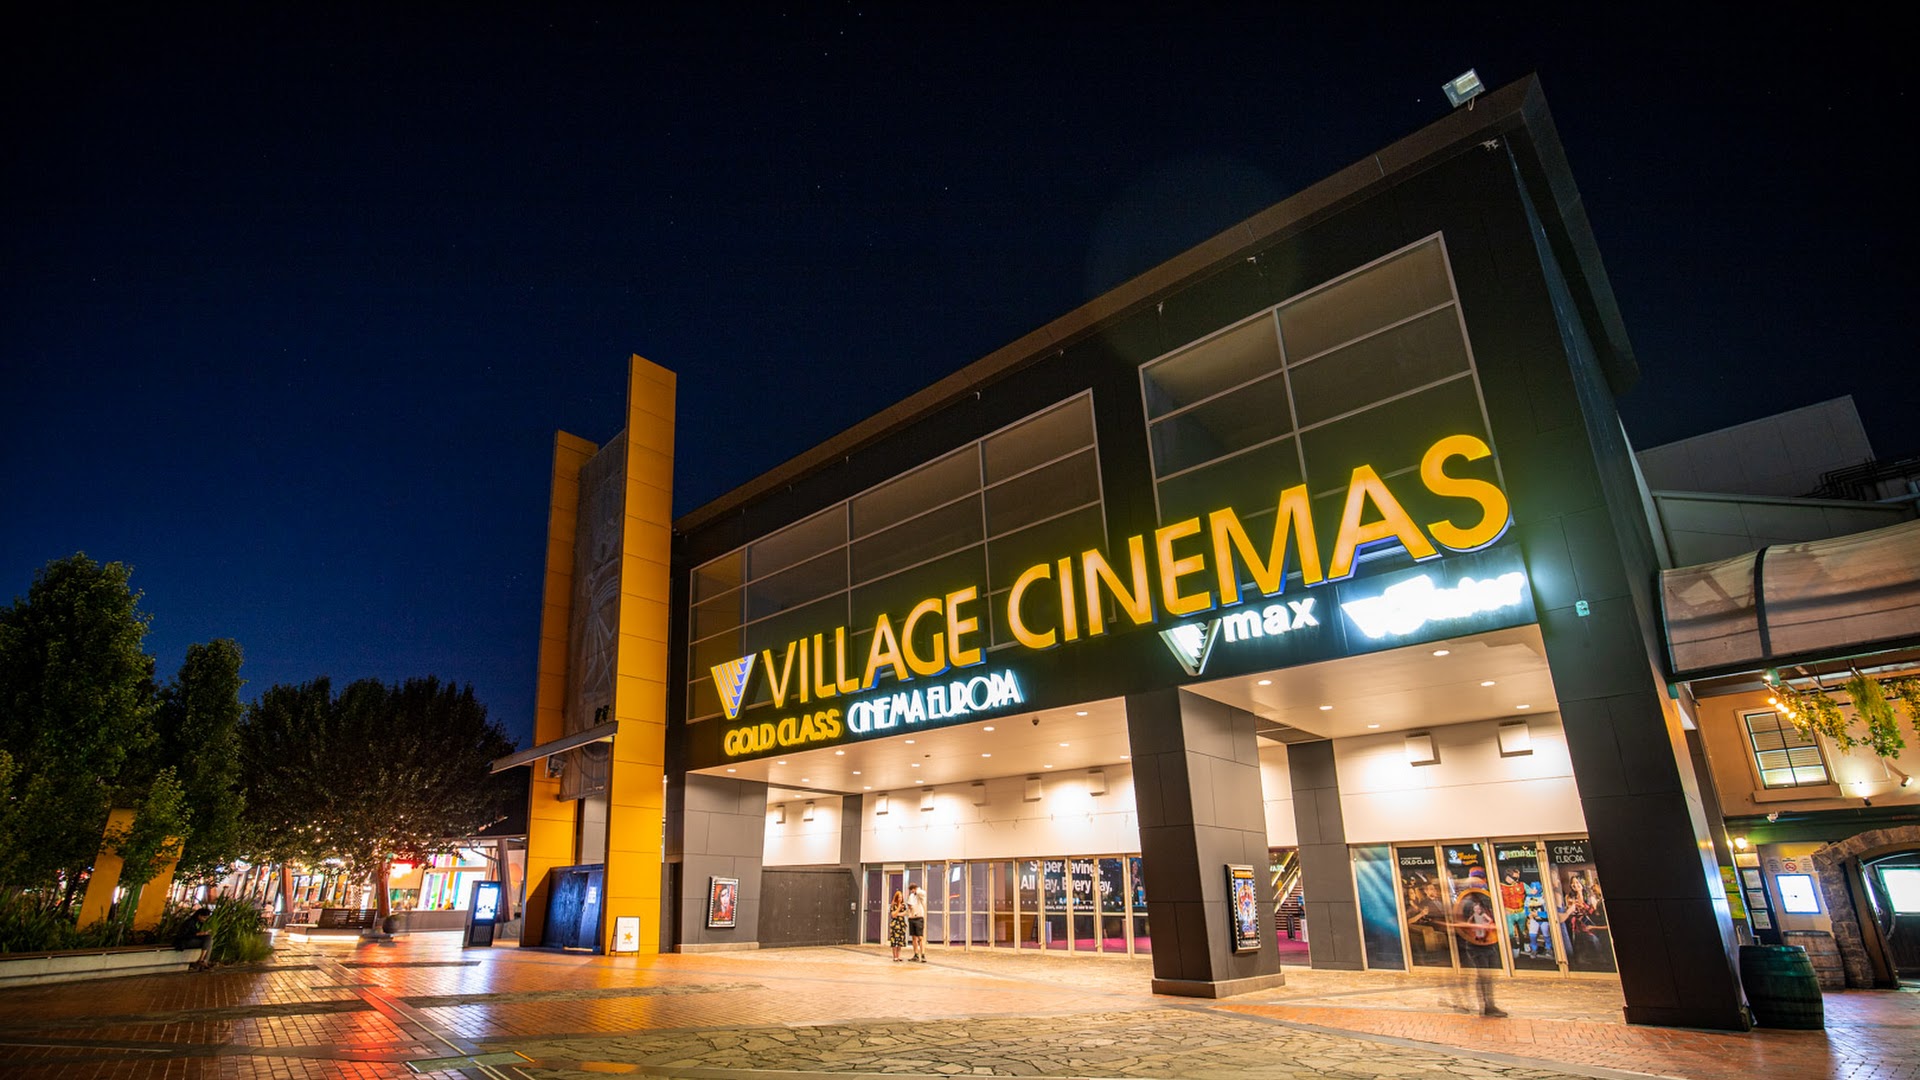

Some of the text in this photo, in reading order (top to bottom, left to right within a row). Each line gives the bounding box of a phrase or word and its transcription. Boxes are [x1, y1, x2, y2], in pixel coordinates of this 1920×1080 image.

[763, 434, 1511, 709] VILLAGE CINEMAS
[847, 668, 1022, 734] CINEMA EUROPA
[724, 708, 842, 757] GOLD CLASS
[1553, 846, 1583, 854] CINEMA
[1555, 854, 1586, 864] EUROPA
[1030, 859, 1103, 876] Sper aving.
[1020, 874, 1036, 890] All
[1042, 877, 1060, 893] ay.
